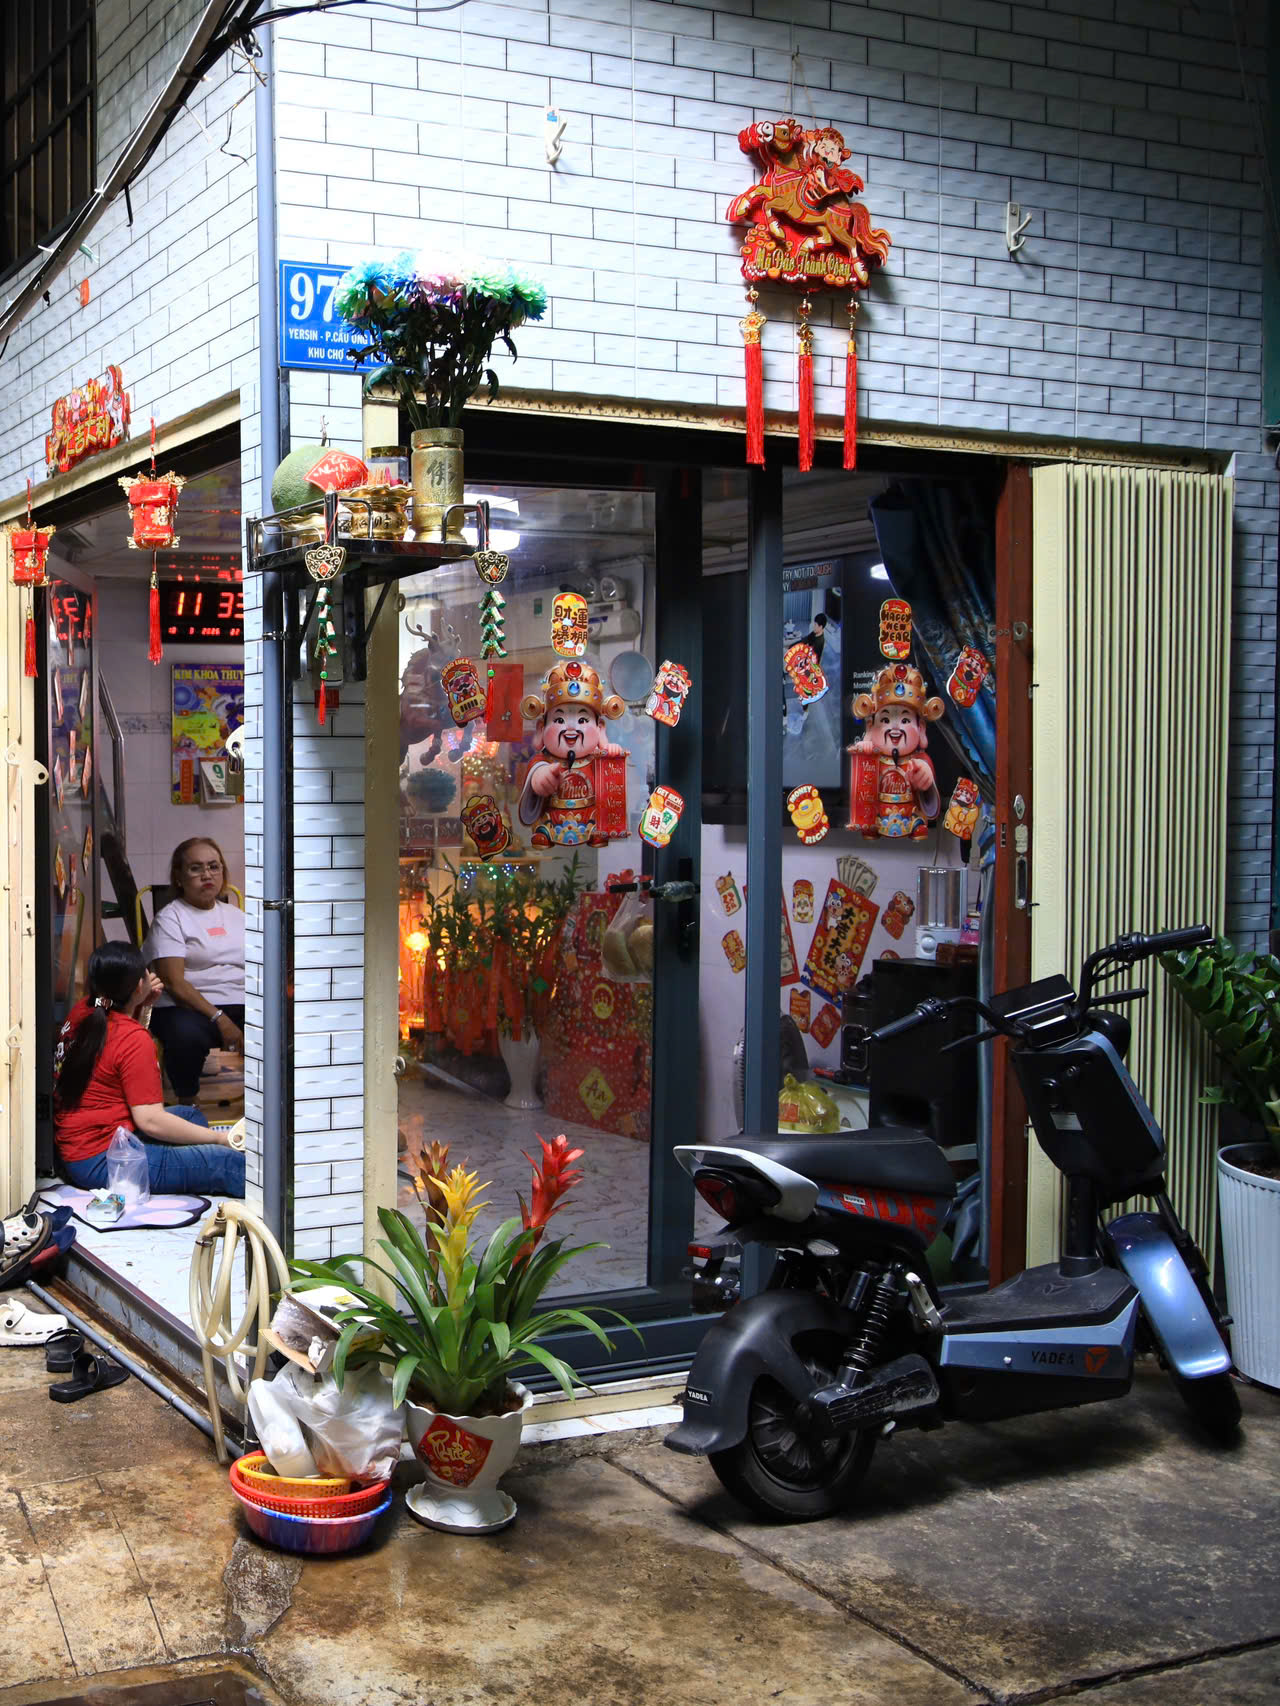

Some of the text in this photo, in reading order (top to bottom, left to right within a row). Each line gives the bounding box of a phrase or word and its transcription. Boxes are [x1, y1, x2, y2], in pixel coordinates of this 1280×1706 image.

[288, 328, 318, 341] YERSIN
[308, 347, 325, 359] KHU
[327, 348, 345, 362] CHỢ
[177, 592, 202, 616] 11
[881, 609, 911, 622] HAPPY
[886, 622, 907, 632] NEW
[880, 631, 911, 643] YEAR
[193, 669, 219, 680] KHOA
[789, 785, 813, 804] MONEY
[805, 826, 828, 844] RICH
[687, 1390, 709, 1402] YADEA
